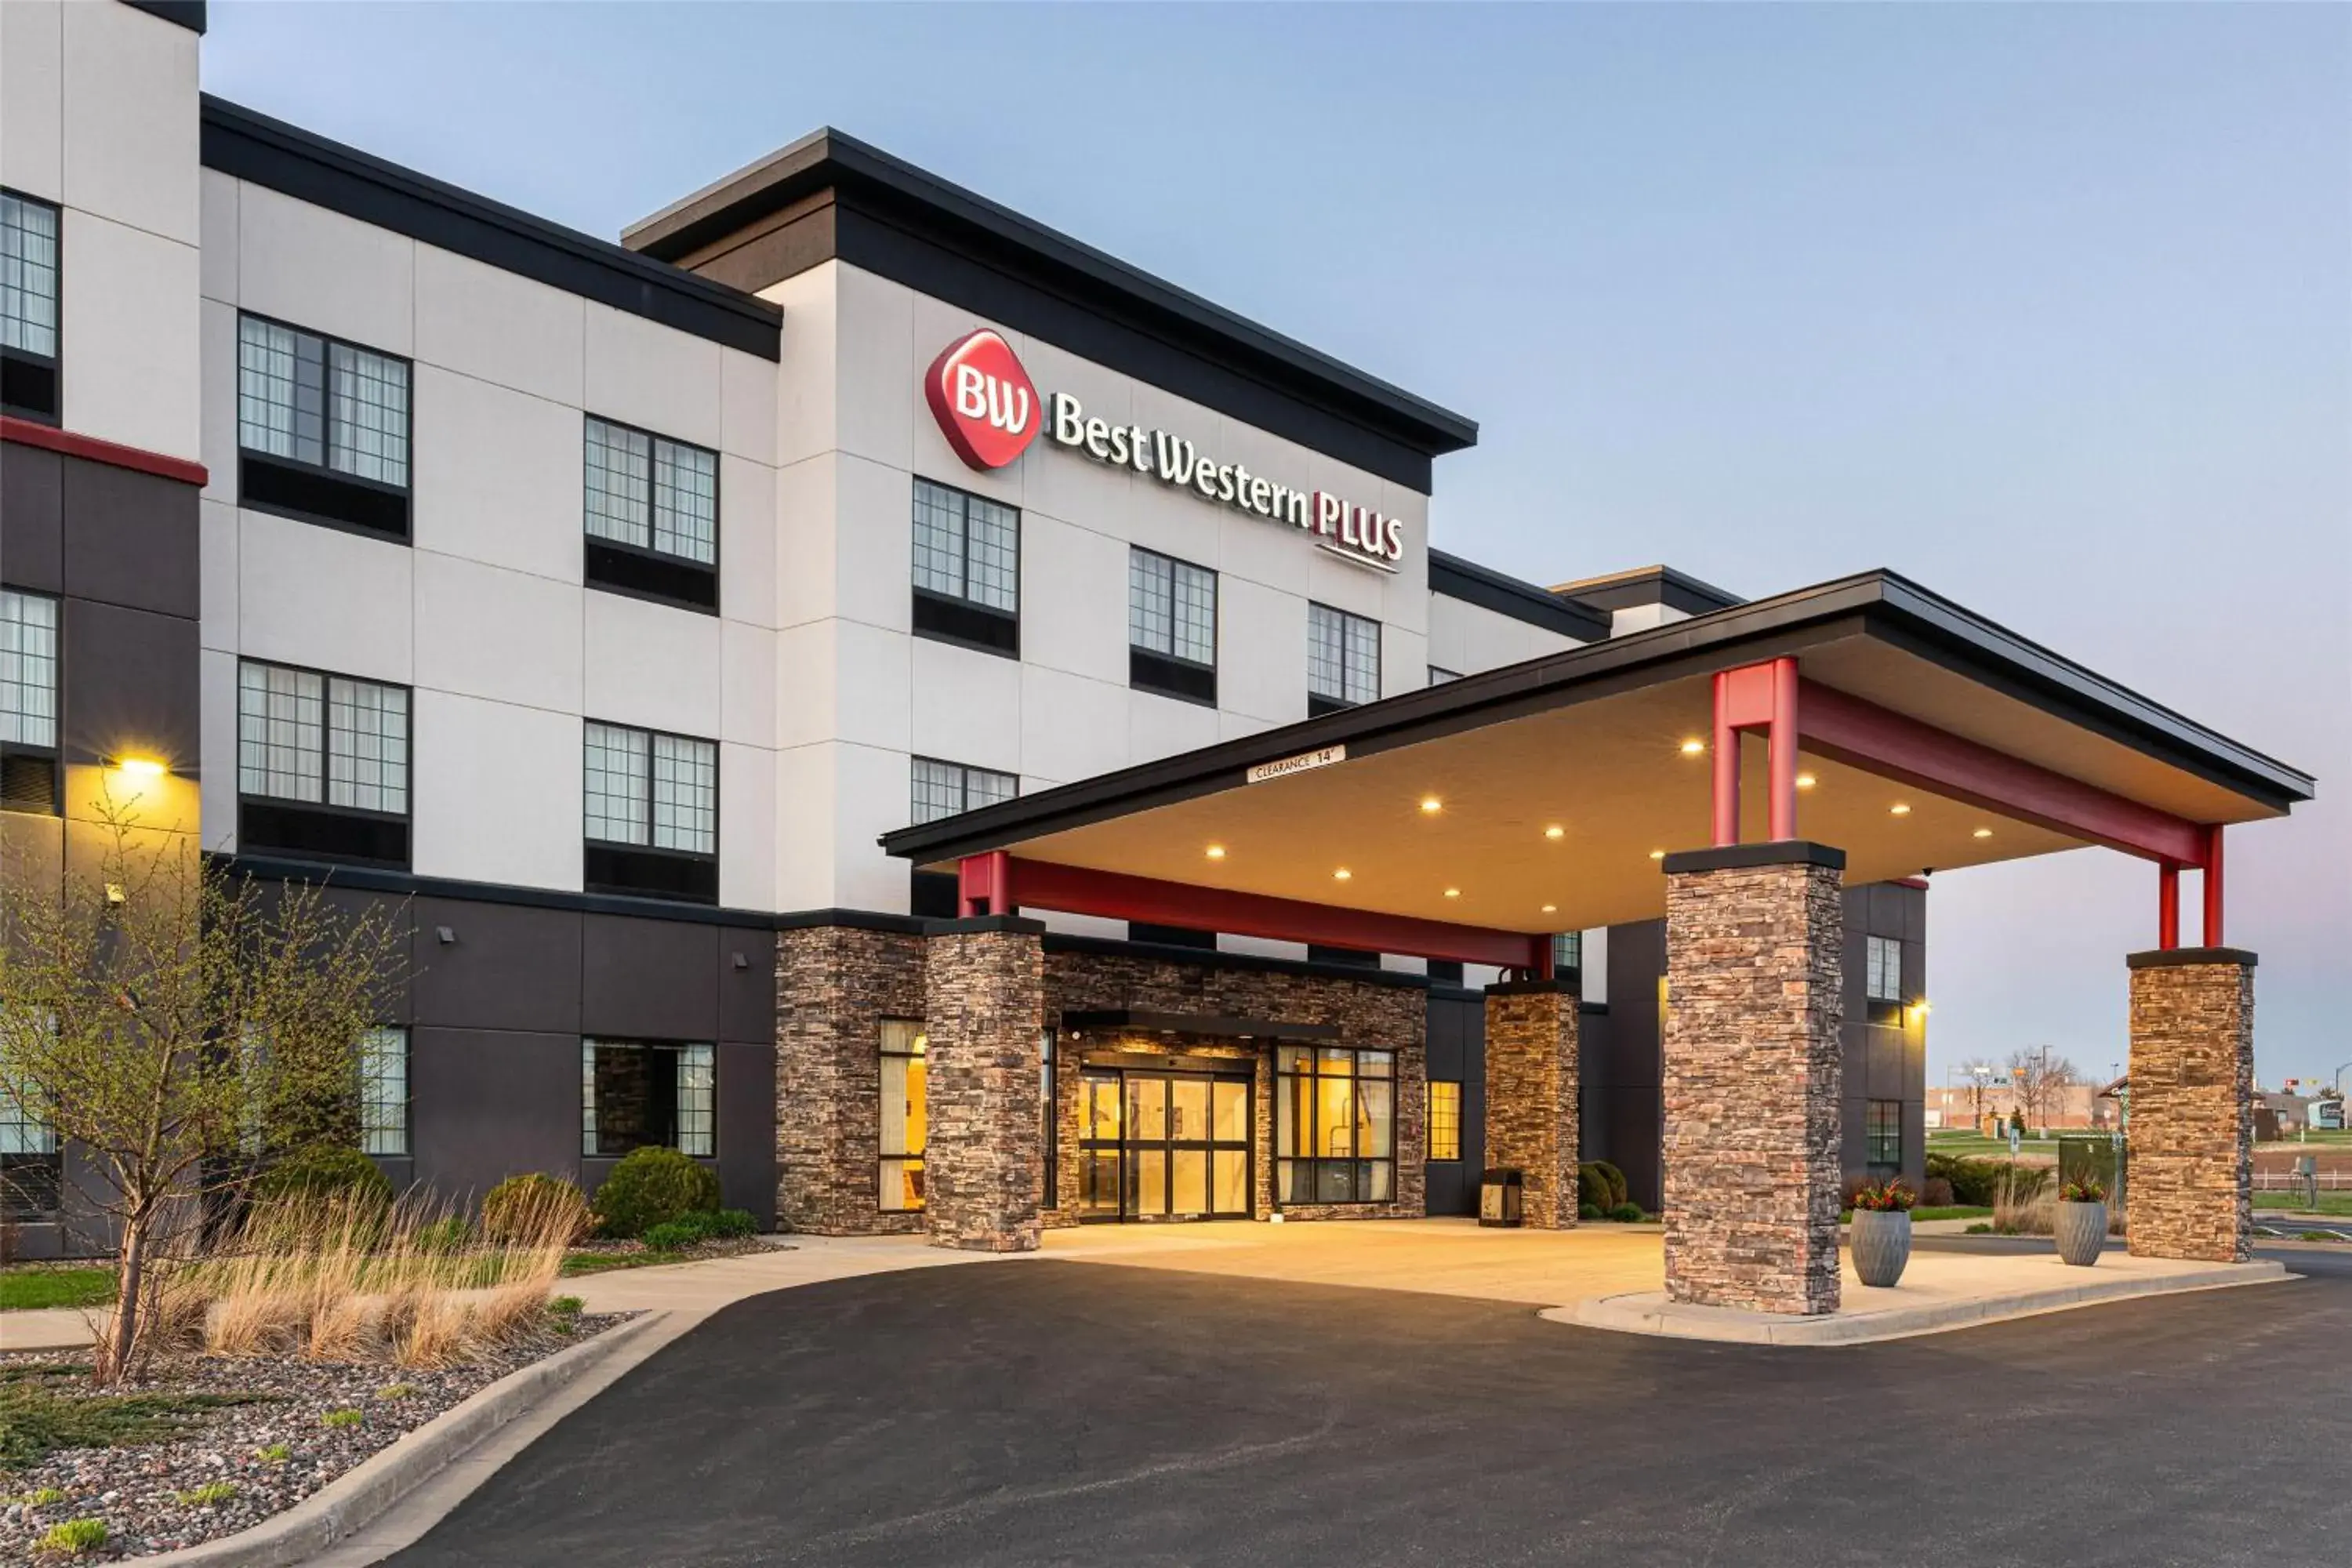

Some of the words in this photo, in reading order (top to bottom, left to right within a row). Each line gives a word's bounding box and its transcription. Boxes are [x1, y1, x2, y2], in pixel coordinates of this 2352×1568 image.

[956, 362, 1029, 434] BW
[1054, 391, 1149, 472] Best
[1153, 429, 1309, 528] Western
[1316, 490, 1403, 561] PLUS
[1255, 755, 1310, 778] CLEARANCE
